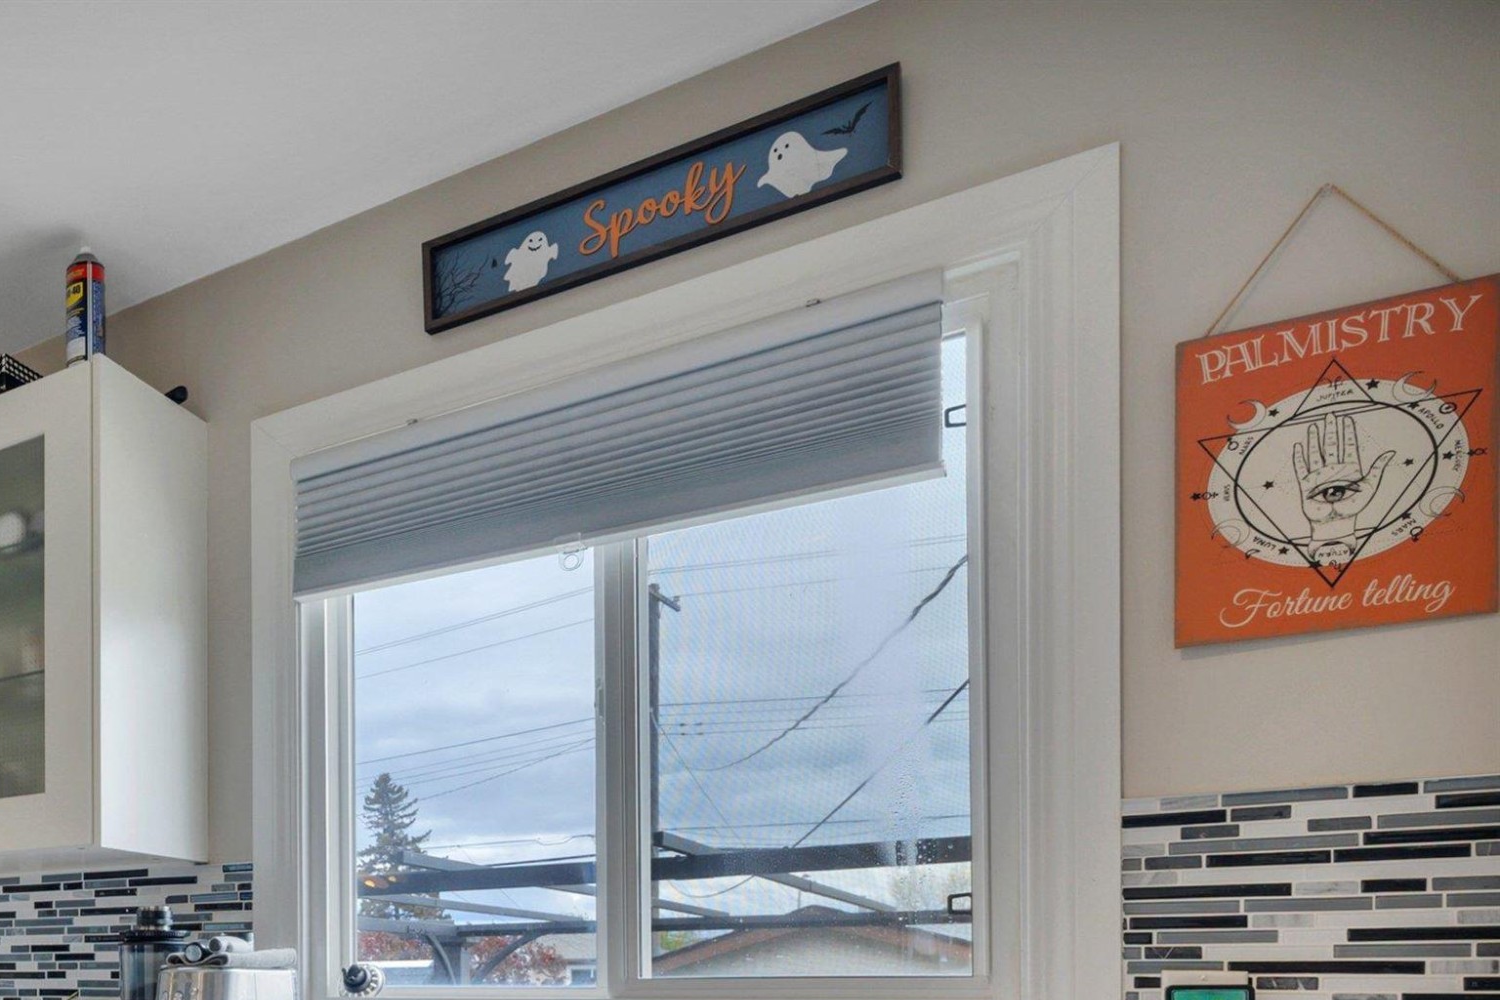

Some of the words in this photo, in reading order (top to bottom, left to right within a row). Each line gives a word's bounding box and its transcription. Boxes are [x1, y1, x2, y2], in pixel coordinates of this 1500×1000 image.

[579, 161, 747, 258] Spooky
[1195, 294, 1483, 385] PALMISTRY
[1316, 388, 1354, 402] JUPITER
[1418, 407, 1444, 429] APOLLO
[1391, 519, 1417, 536] MARS
[1253, 536, 1277, 550] LUNA
[1219, 587, 1353, 628] Fortune
[1362, 573, 1455, 612] telling
